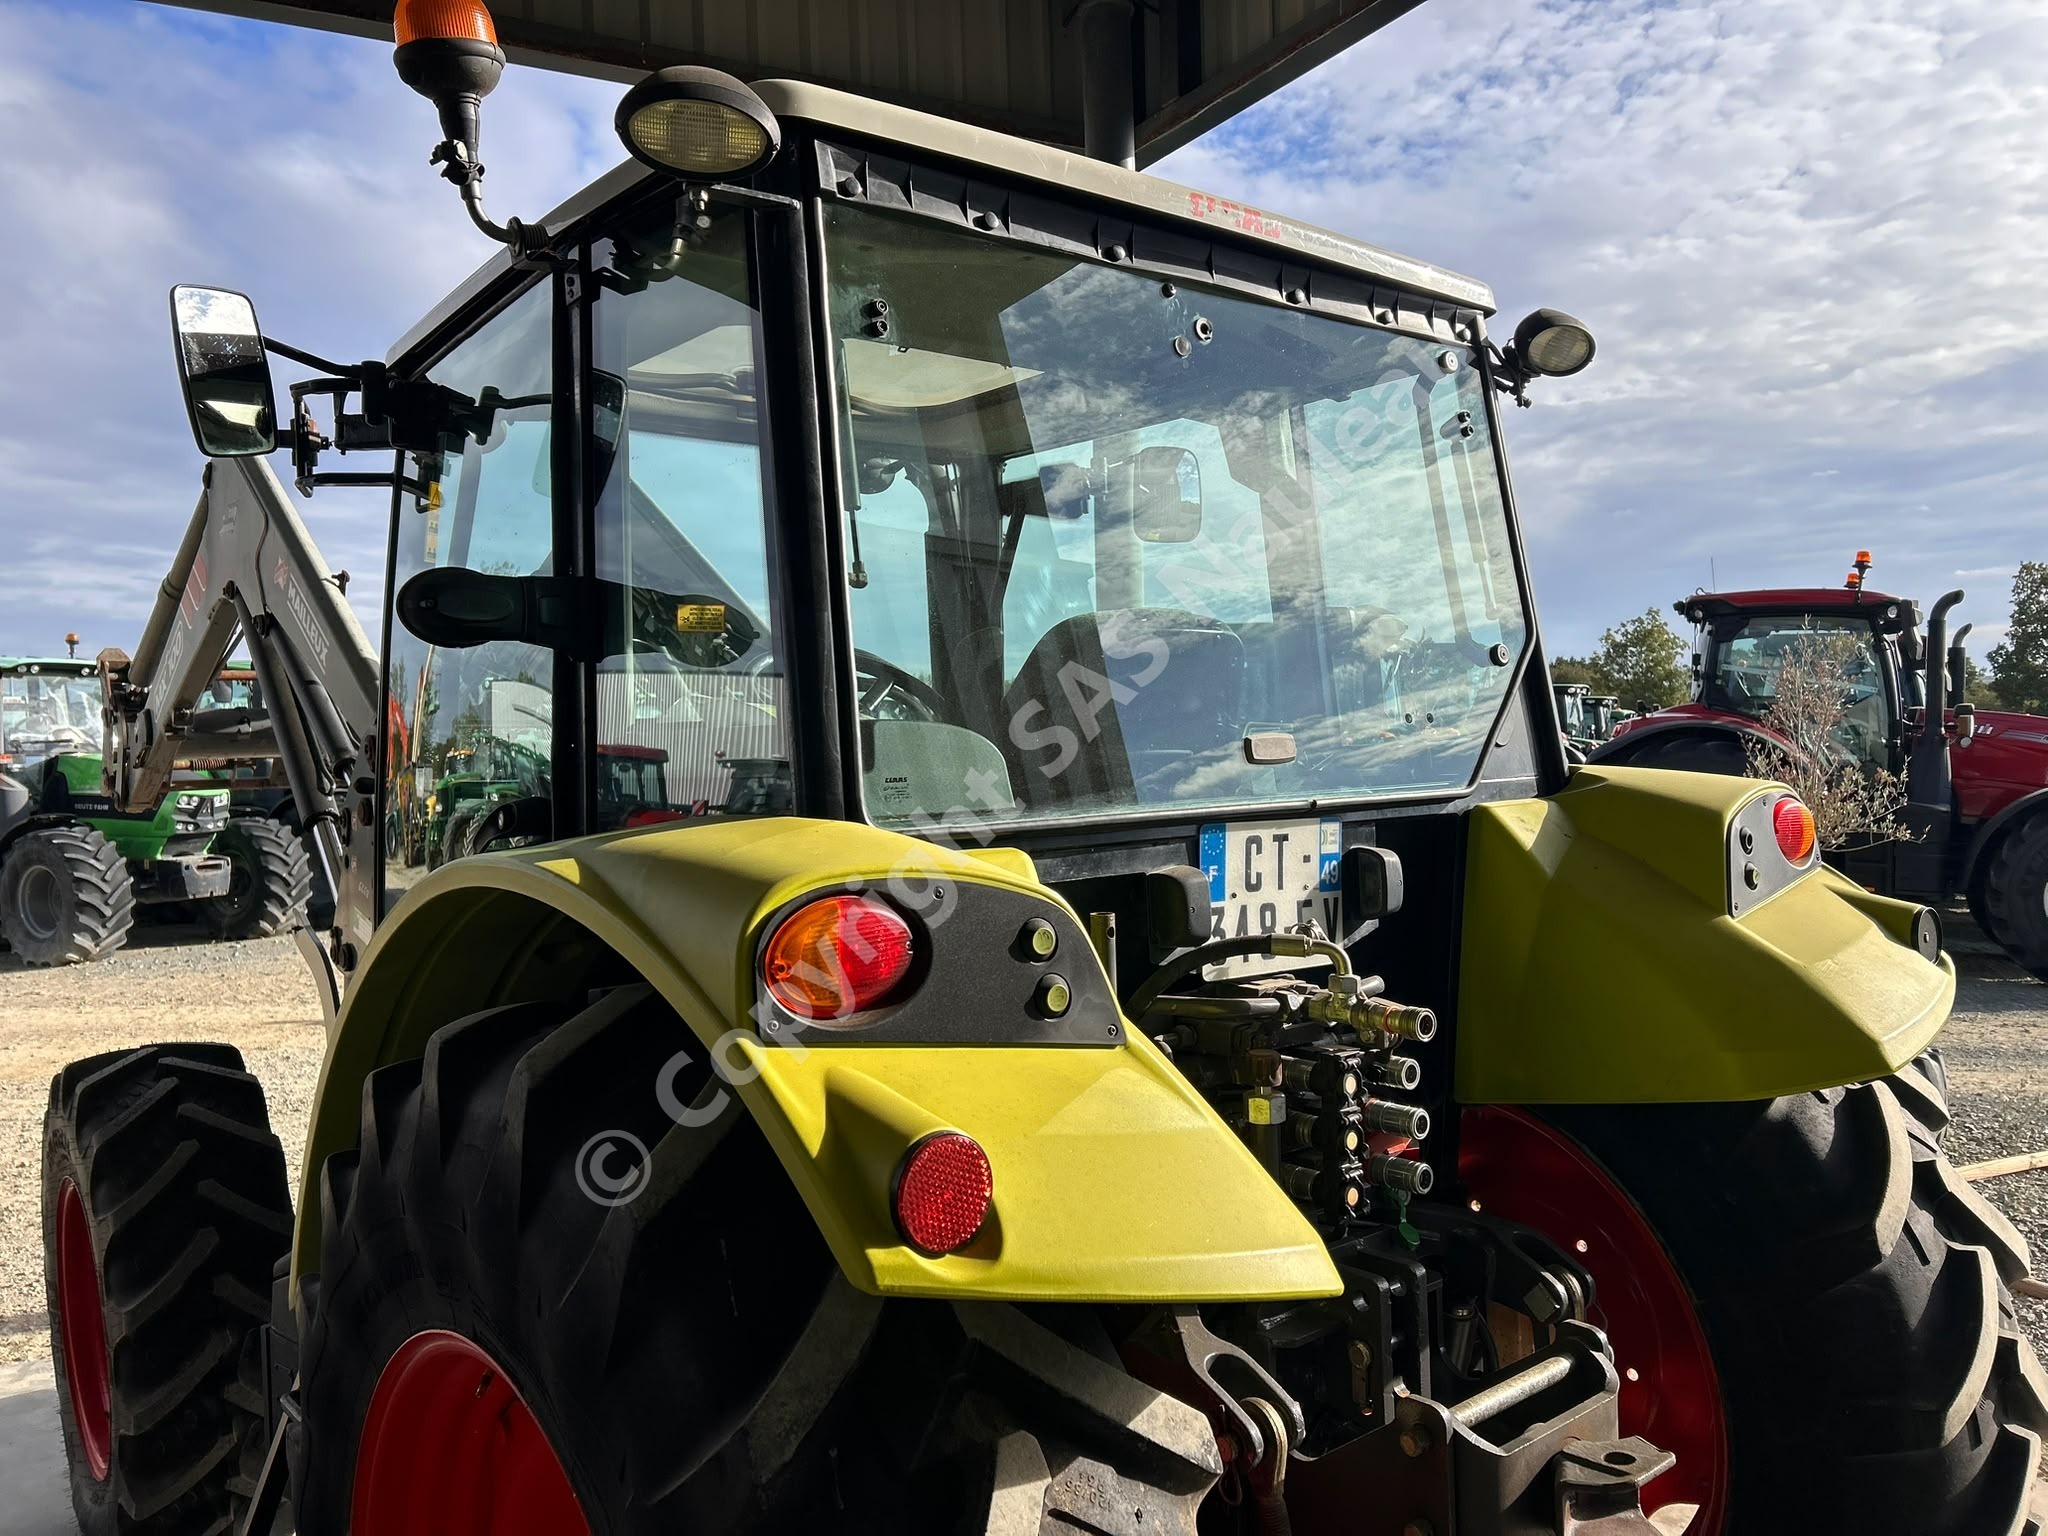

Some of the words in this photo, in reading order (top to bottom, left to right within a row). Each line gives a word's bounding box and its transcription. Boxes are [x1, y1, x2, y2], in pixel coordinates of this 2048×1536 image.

[288, 579, 328, 667] MAILLEUX
[884, 776, 908, 784] CLAAS
[1209, 864, 1219, 882] F
[1320, 859, 1339, 885] 49
